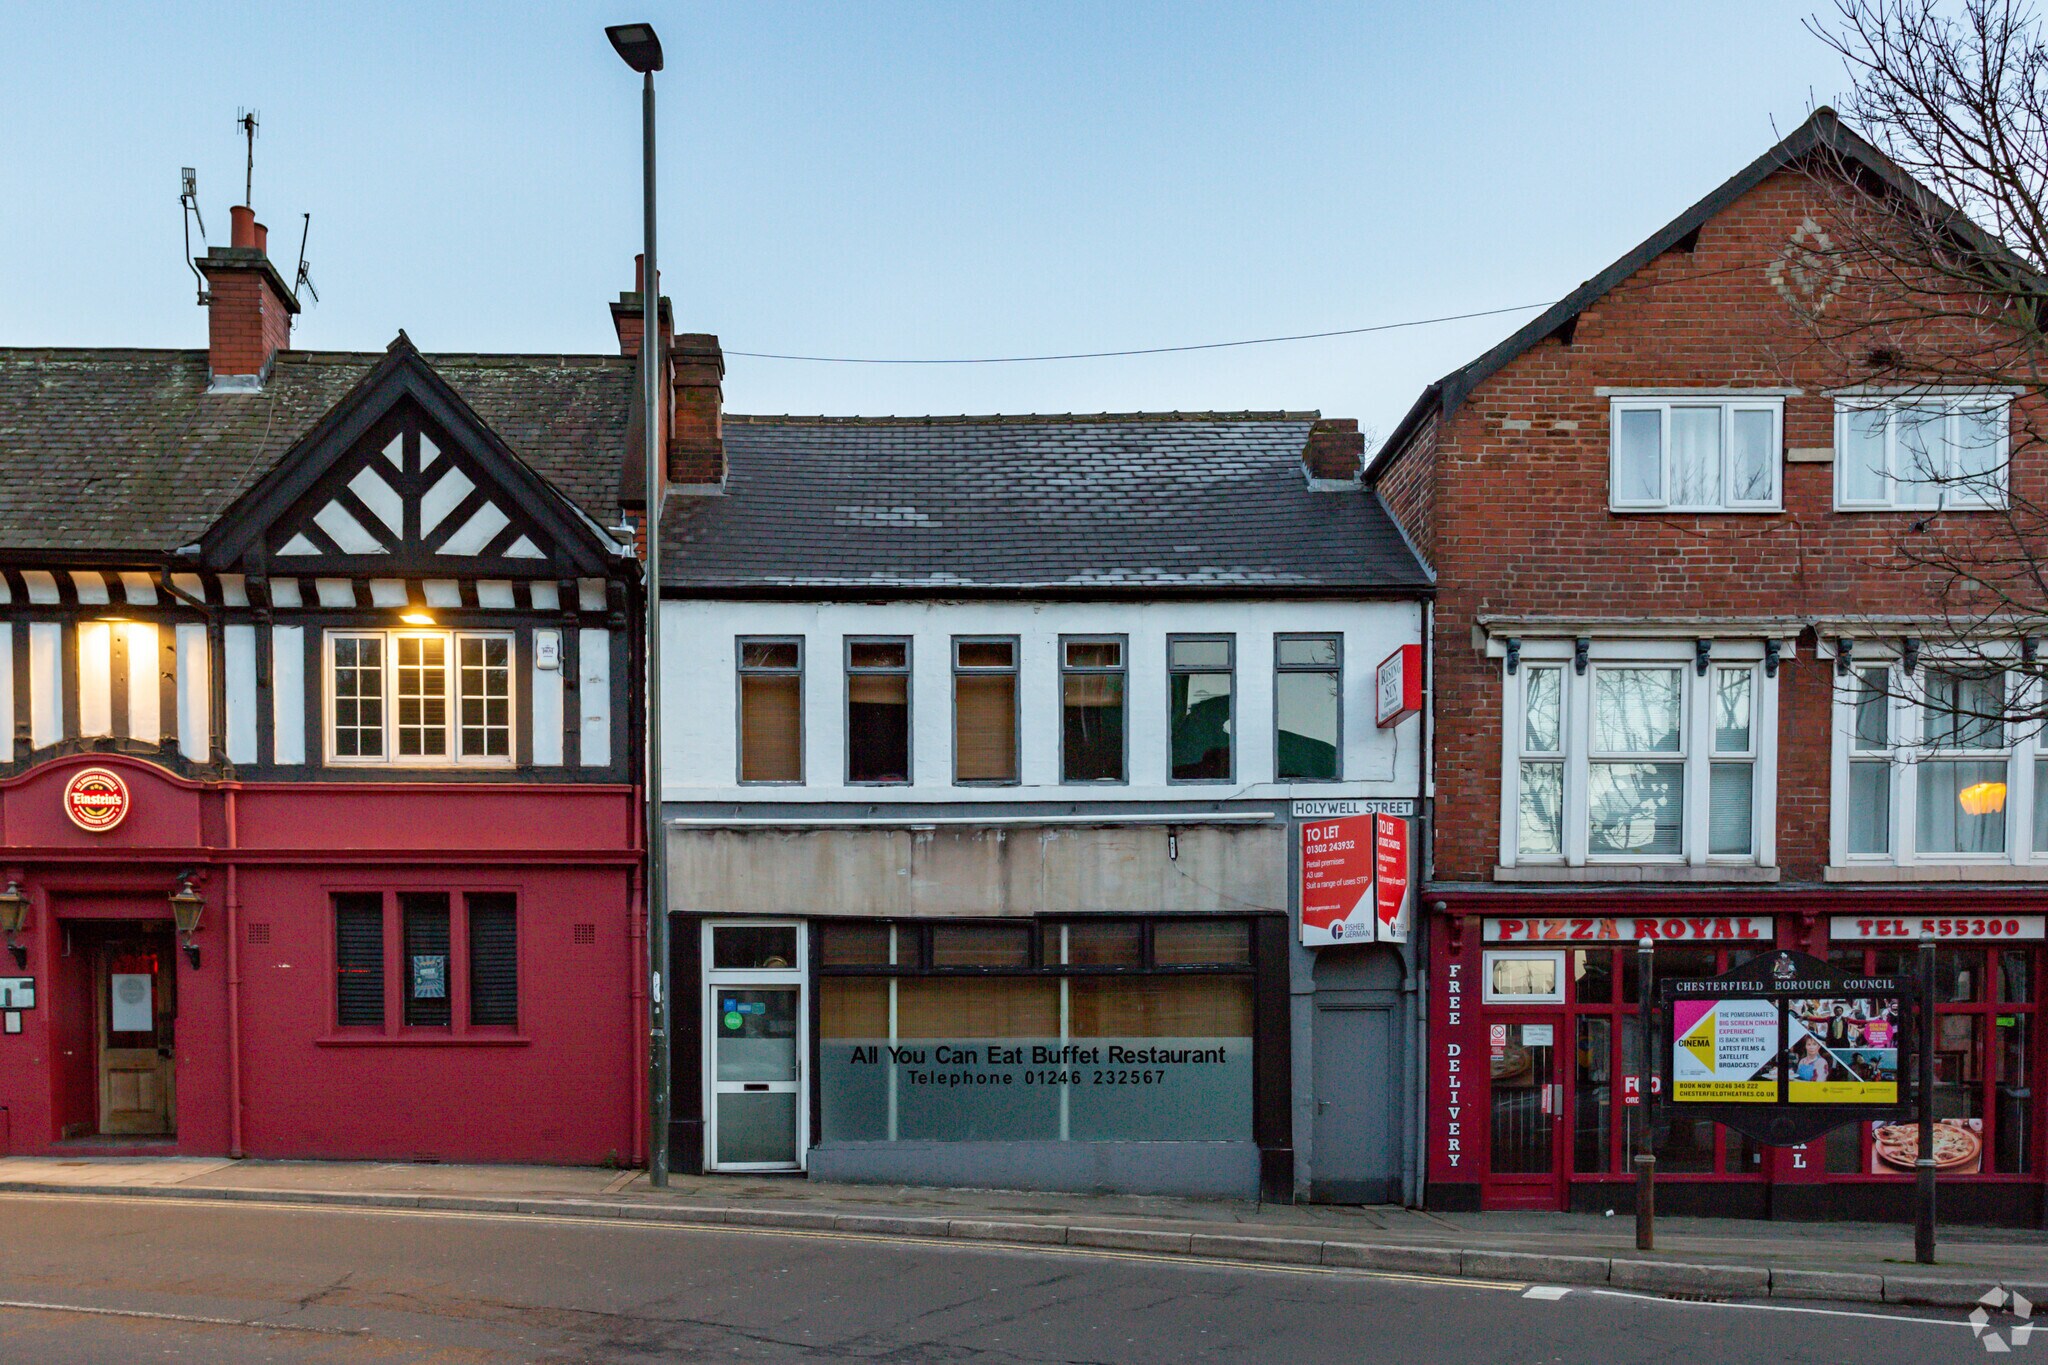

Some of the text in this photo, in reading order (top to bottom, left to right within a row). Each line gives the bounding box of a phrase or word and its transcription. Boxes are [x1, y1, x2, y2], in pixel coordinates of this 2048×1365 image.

[71, 792, 122, 805] Einstein's
[1295, 801, 1412, 814] HOLYWELL STREET
[1306, 825, 1340, 842] TO LET
[1379, 820, 1386, 834] TO
[1306, 840, 1355, 855] 01302 243932
[1344, 923, 1365, 931] FISHER
[1498, 918, 1759, 939] PIZZA ROYAL
[1856, 919, 2020, 936] TEL 555300
[1344, 930, 1371, 939] GERMAN
[1676, 979, 1895, 992] CHESTERFIELD BOROUGH COUNCIL
[1678, 1039, 1711, 1048] CINEMA
[851, 1045, 1226, 1065] All You Can Eat Buffet Restaurant
[1448, 965, 1462, 1167] FREE DELIVERY
[907, 1070, 1166, 1088] Telephone 01246 232567
